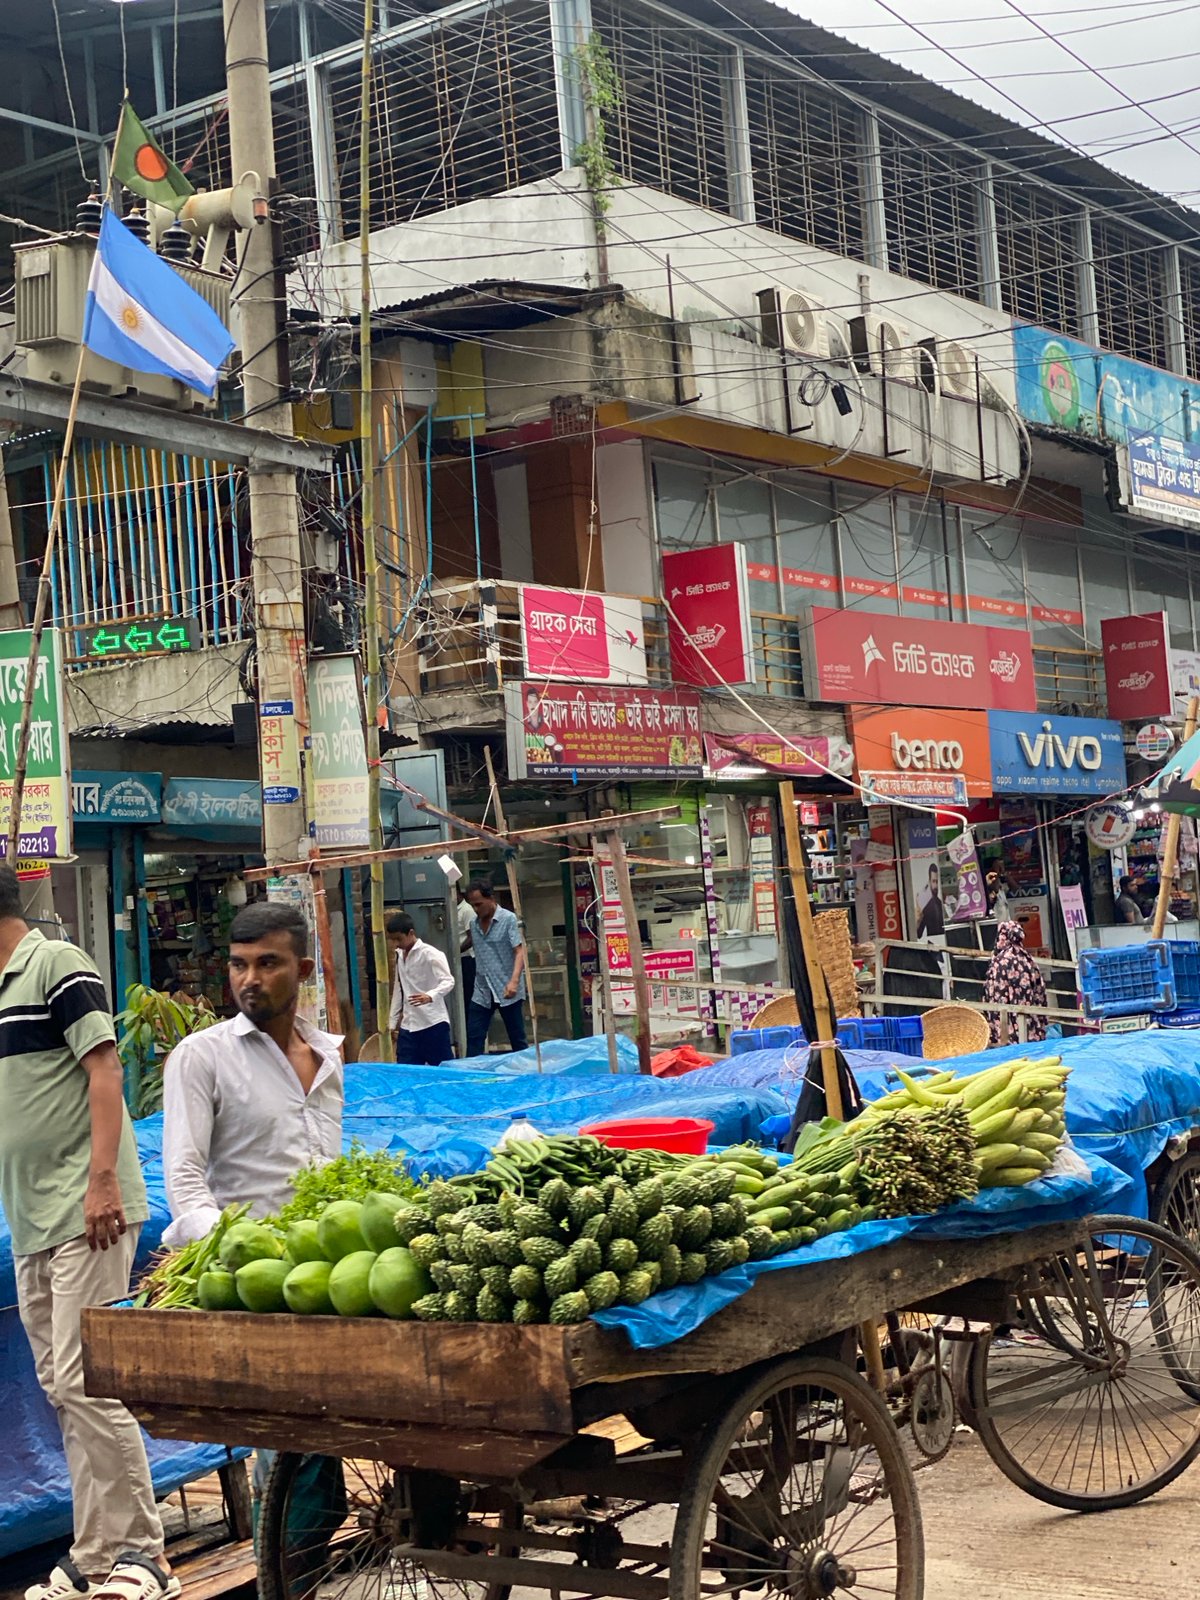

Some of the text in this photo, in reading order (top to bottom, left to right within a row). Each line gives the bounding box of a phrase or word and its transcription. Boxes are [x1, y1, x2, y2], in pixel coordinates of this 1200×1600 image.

[686, 584, 704, 596] সিটি
[530, 611, 597, 636] গ্রাহক সেবা
[892, 641, 975, 679] সিটি ব্যাংক
[890, 731, 964, 770] benco
[1016, 720, 1102, 770] vivo
[996, 775, 1012, 785] oppo
[912, 828, 932, 838] vivo
[1010, 887, 1042, 898] vivo
[1064, 908, 1086, 929] EMI
